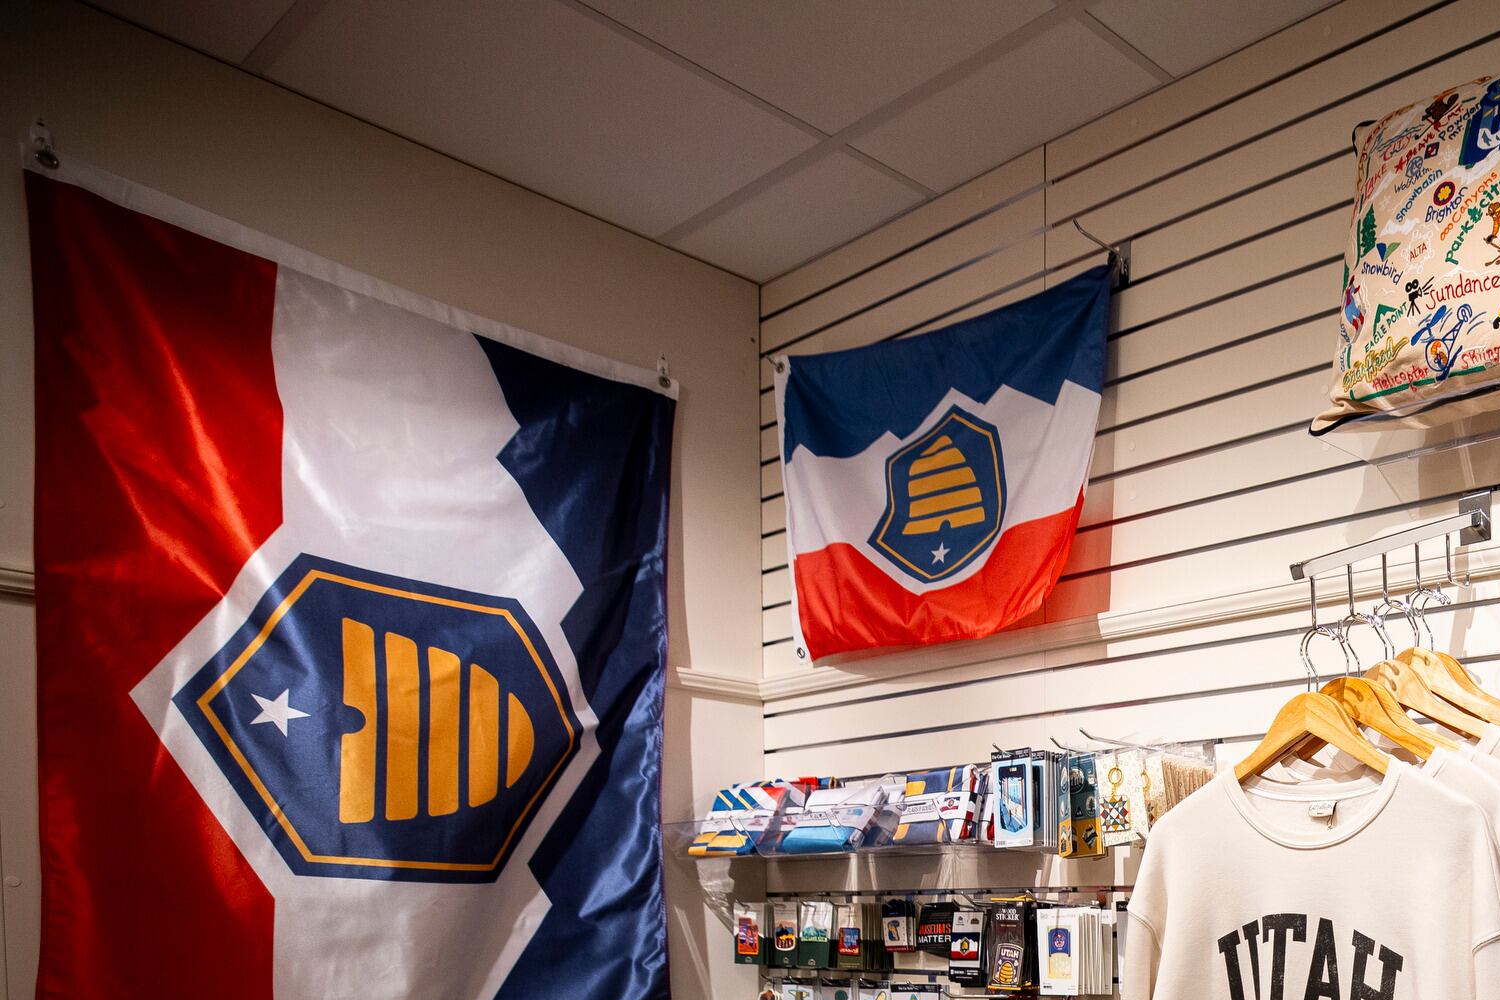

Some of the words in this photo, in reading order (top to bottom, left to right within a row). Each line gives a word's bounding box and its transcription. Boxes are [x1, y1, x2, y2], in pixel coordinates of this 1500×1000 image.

[1425, 186, 1468, 223] Brighton
[1409, 242, 1428, 261] ALTA
[1364, 324, 1388, 354] EAGLE
[1385, 302, 1408, 329] POINT
[1372, 365, 1429, 393] Helicopter
[995, 913, 1020, 921] STICKER
[1000, 948, 1020, 959] UTAH
